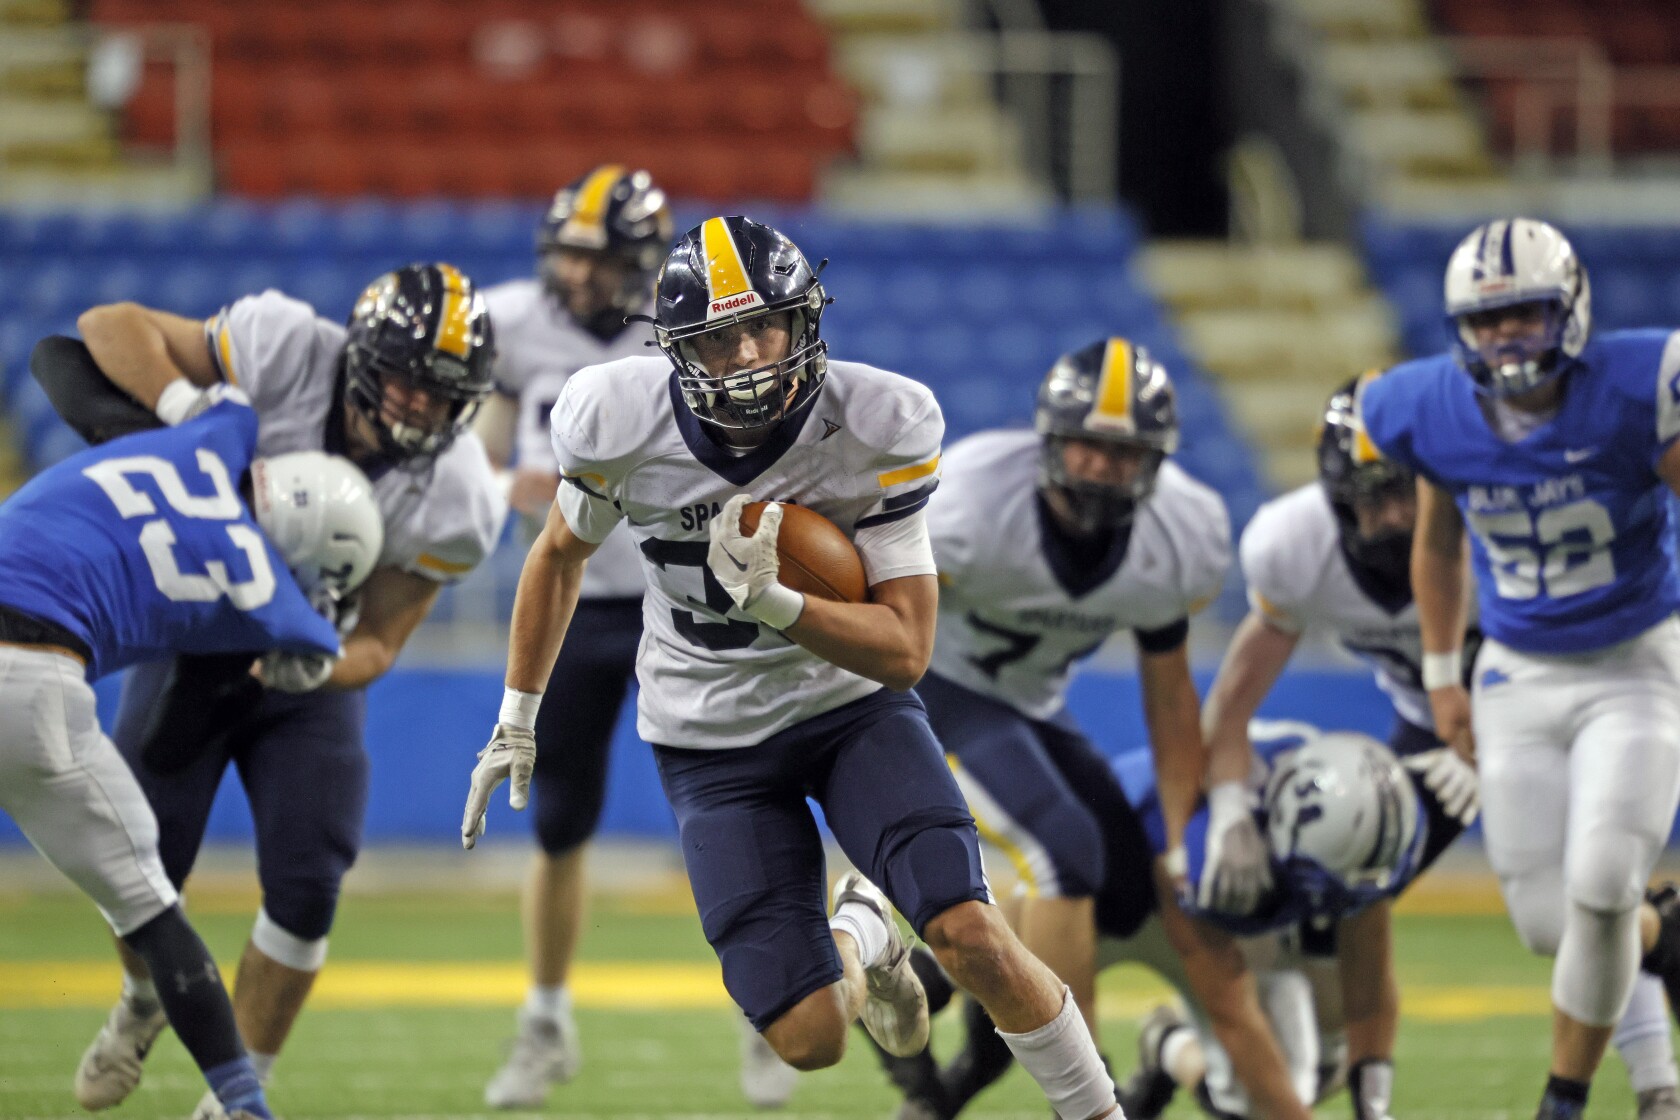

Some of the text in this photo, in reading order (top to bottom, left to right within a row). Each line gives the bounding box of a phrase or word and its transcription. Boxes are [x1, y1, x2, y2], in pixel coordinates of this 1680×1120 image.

[711, 293, 755, 313] Riddell
[82, 448, 277, 611] 23
[1466, 500, 1616, 600] 52
[639, 535, 797, 652] 3
